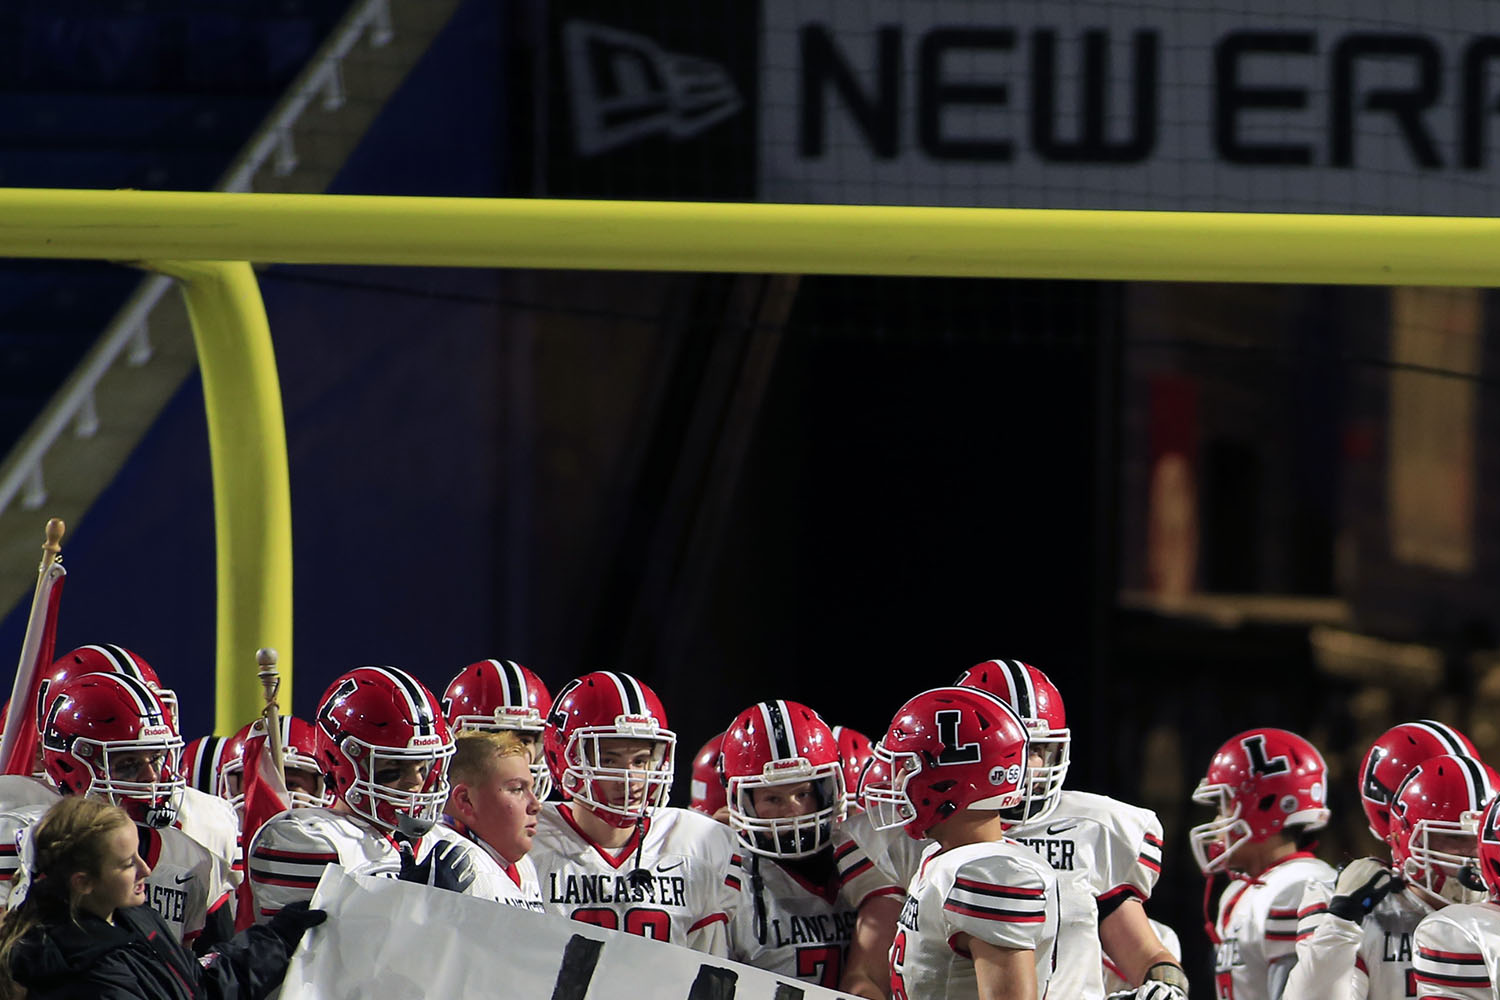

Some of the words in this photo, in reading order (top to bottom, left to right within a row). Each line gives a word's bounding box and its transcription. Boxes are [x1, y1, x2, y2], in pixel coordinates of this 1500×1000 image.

[803, 23, 1161, 164] NEW
[413, 737, 440, 746] Riddell
[935, 709, 981, 766] L
[1240, 734, 1291, 777] L
[550, 873, 686, 906] LANCASTER
[772, 910, 858, 948] LANCAS
